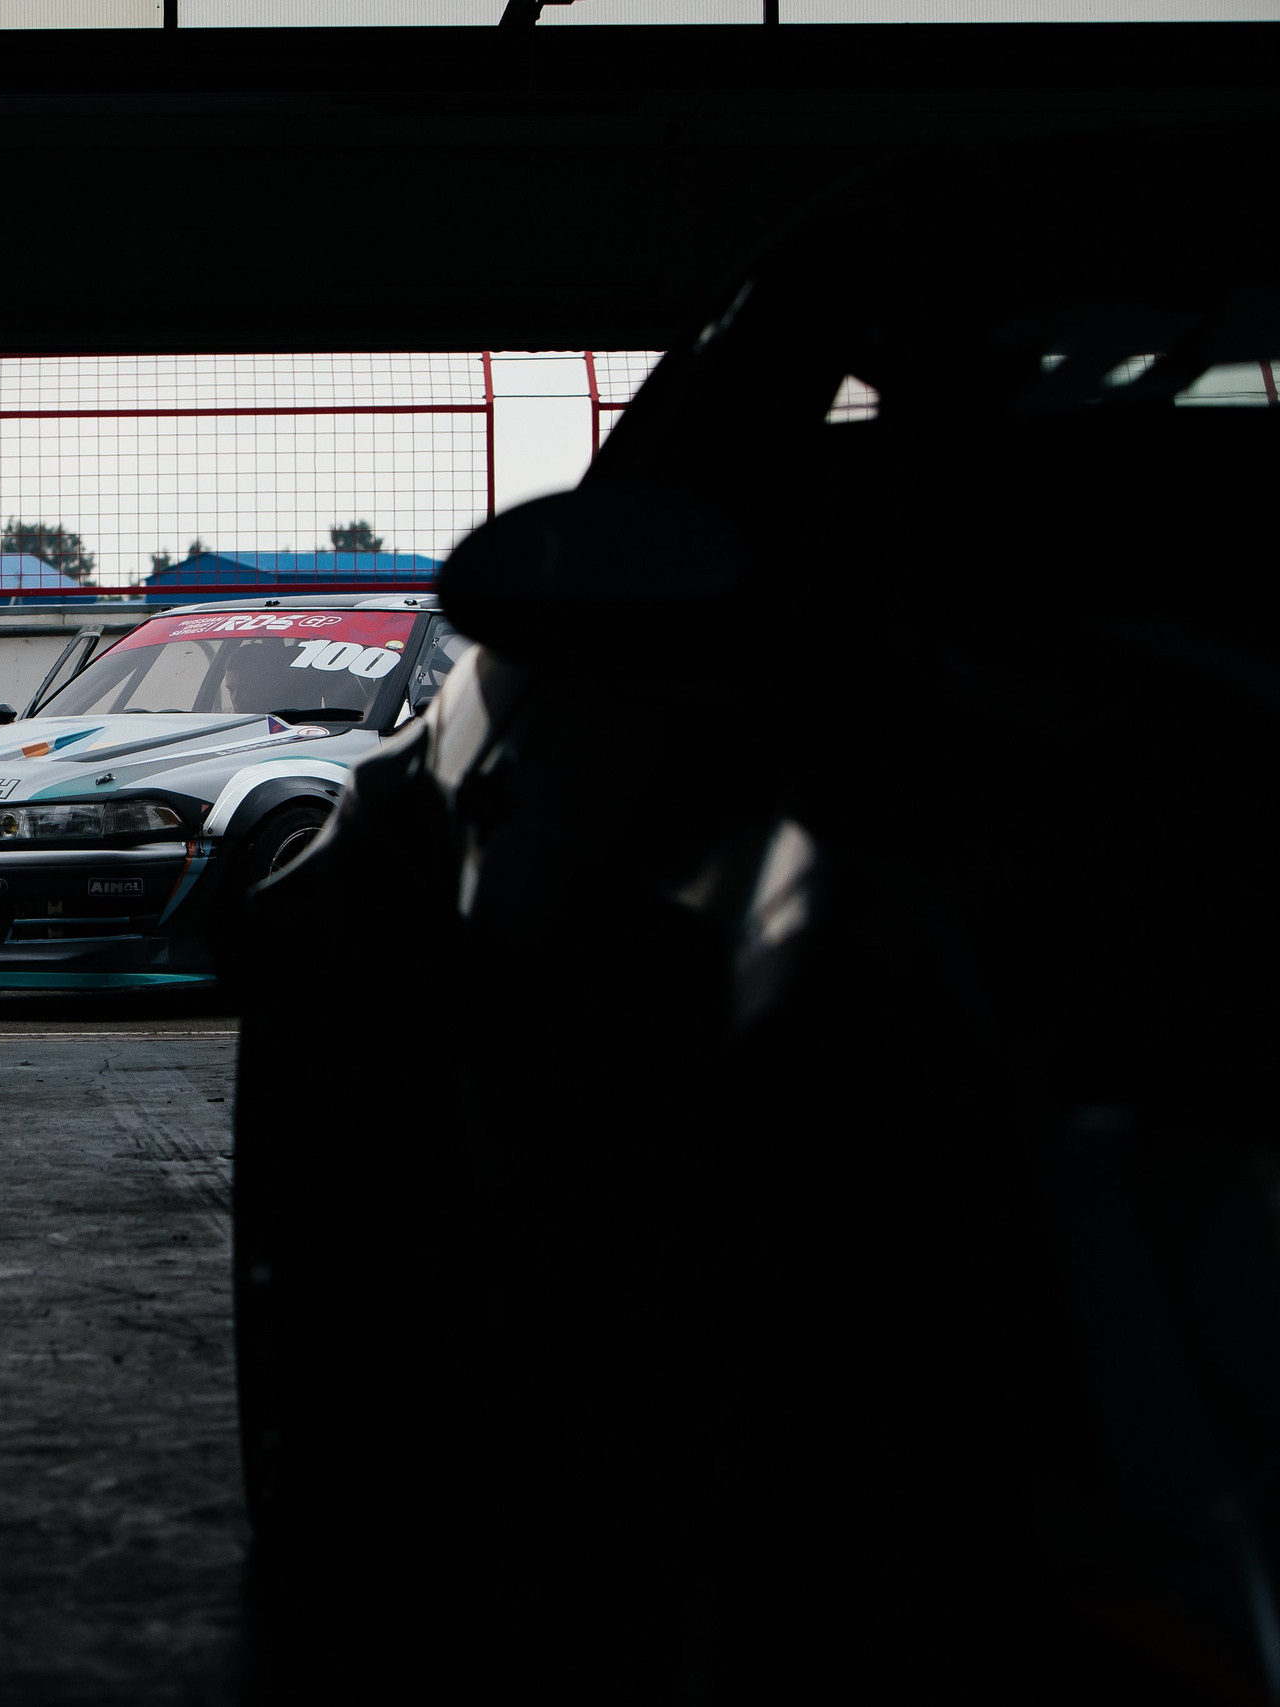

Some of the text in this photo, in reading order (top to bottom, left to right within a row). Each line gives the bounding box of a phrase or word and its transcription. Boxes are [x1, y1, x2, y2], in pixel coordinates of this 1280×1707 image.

[213, 615, 342, 631] RDS GP
[290, 640, 401, 679] 100
[91, 881, 141, 893] AIMOL
